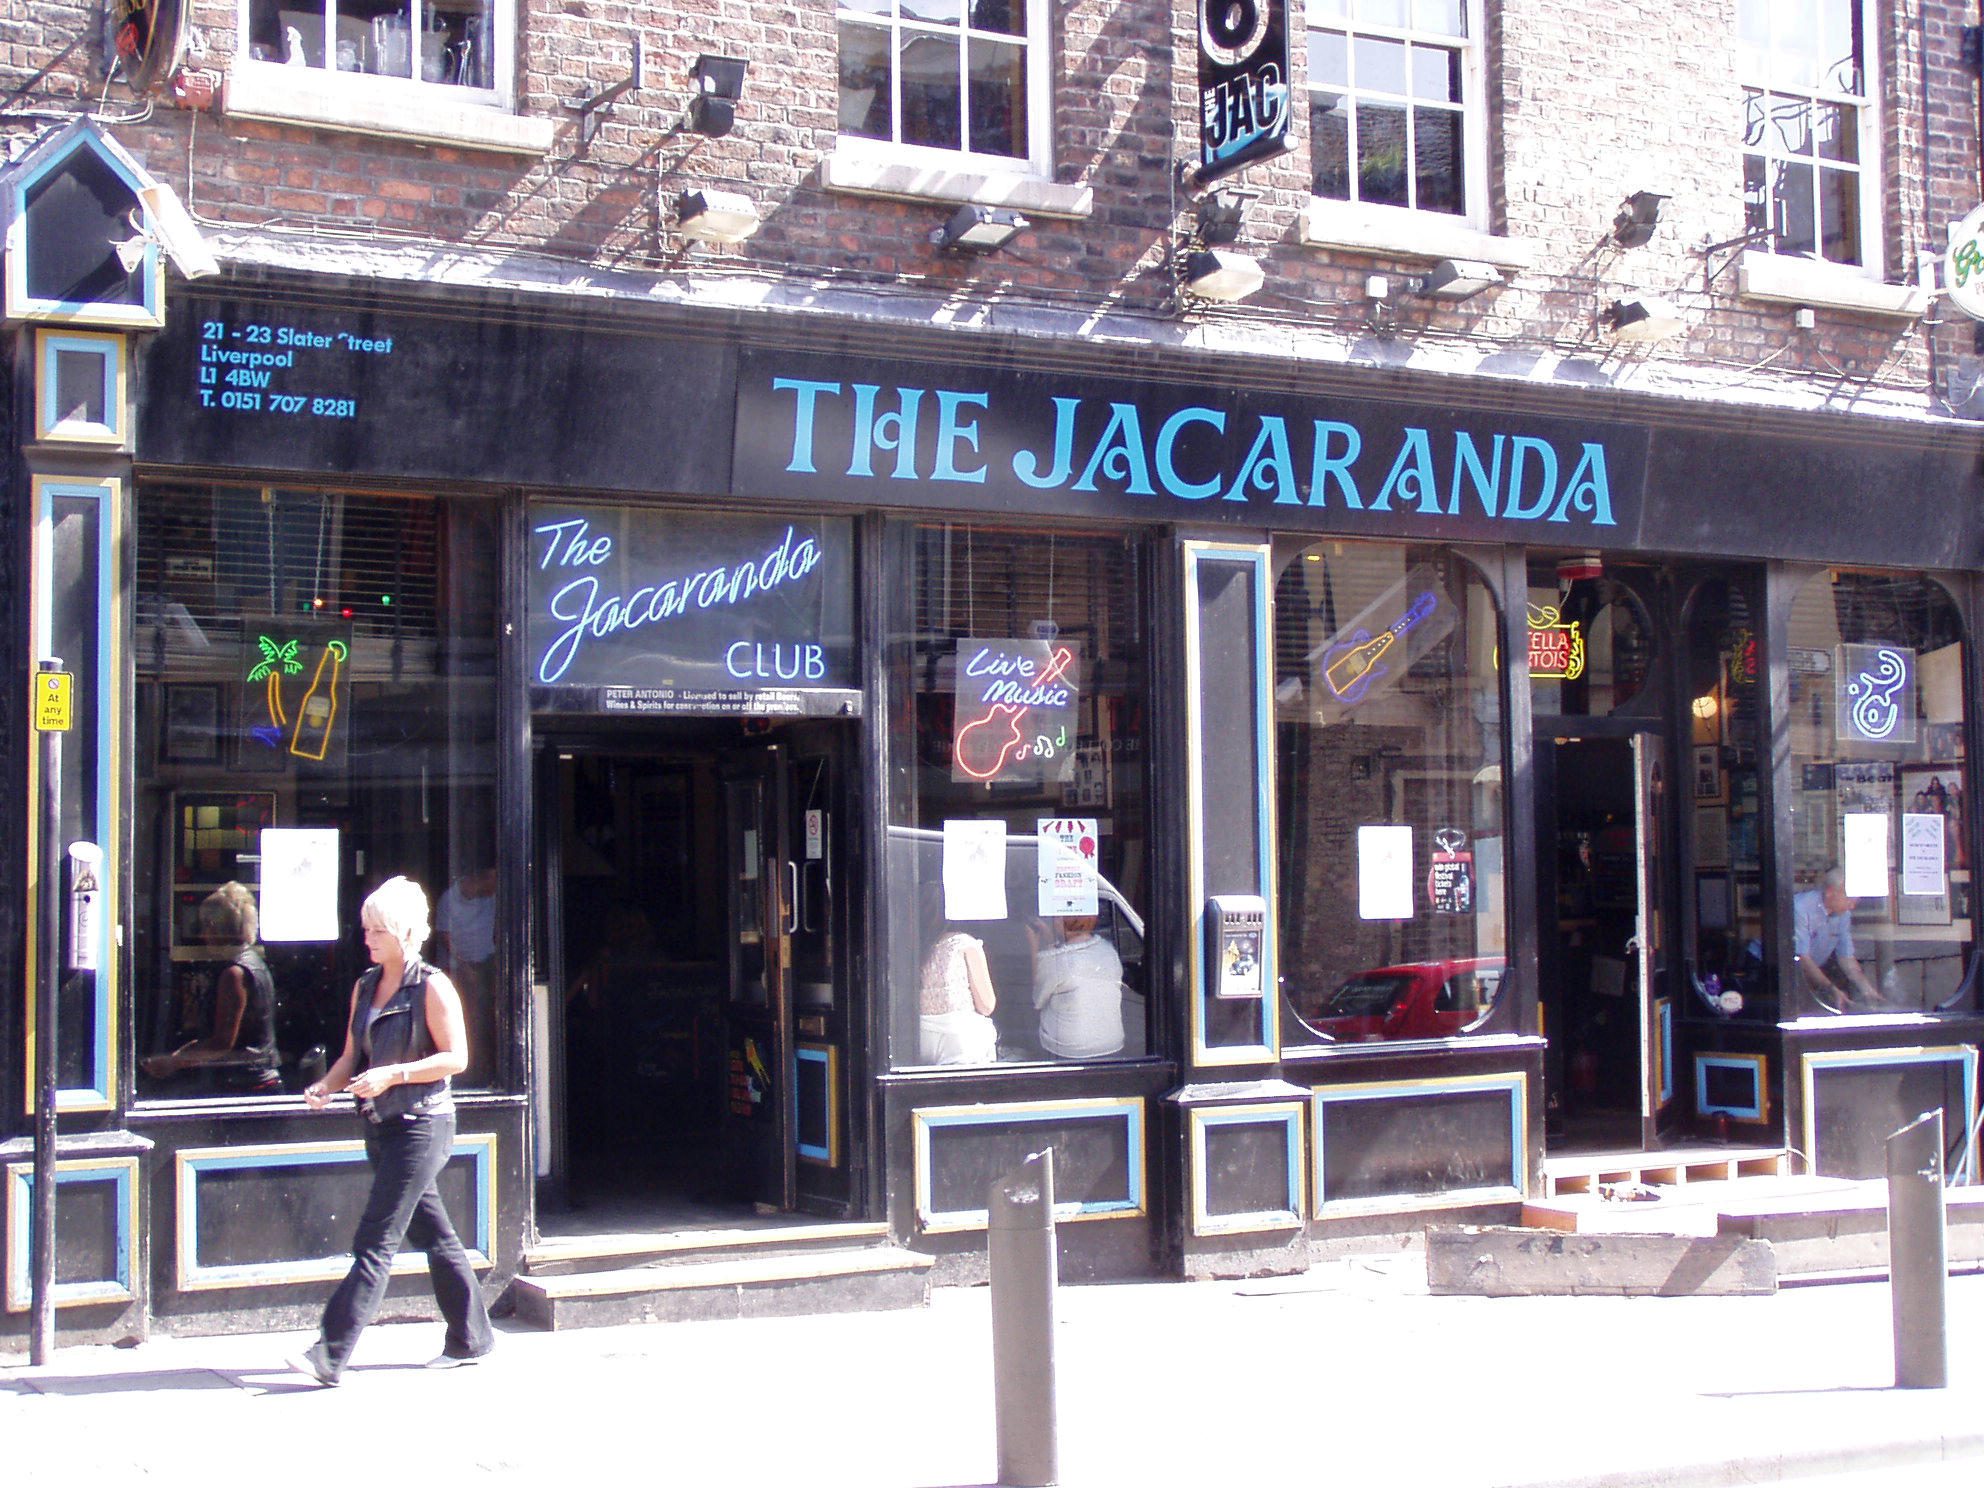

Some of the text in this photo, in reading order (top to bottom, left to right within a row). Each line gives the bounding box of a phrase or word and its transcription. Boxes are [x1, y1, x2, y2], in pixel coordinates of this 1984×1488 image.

[1206, 62, 1280, 149] JAC
[203, 322, 224, 339] 21
[246, 325, 271, 344] 23
[277, 328, 333, 348] Slater
[338, 333, 392, 353] treet
[201, 344, 292, 368] Liverpool
[200, 367, 271, 388] L1 4BW
[200, 390, 355, 416] T. 0151 707 8281
[774, 377, 1617, 526] THE JACARANDA
[535, 519, 612, 570] The
[539, 525, 821, 683] Jacaranda
[726, 641, 825, 679] CLUB
[966, 648, 1035, 677] Live
[48, 694, 59, 702] At
[606, 689, 633, 699] PETER
[635, 690, 674, 699] ANTONIO
[719, 691, 727, 700] to
[606, 700, 629, 709] Wines
[630, 701, 636, 709] &
[637, 700, 661, 711] Spirits
[663, 700, 674, 710] for
[982, 679, 1069, 707] Music
[42, 716, 64, 725] time
[44, 707, 62, 715] any
